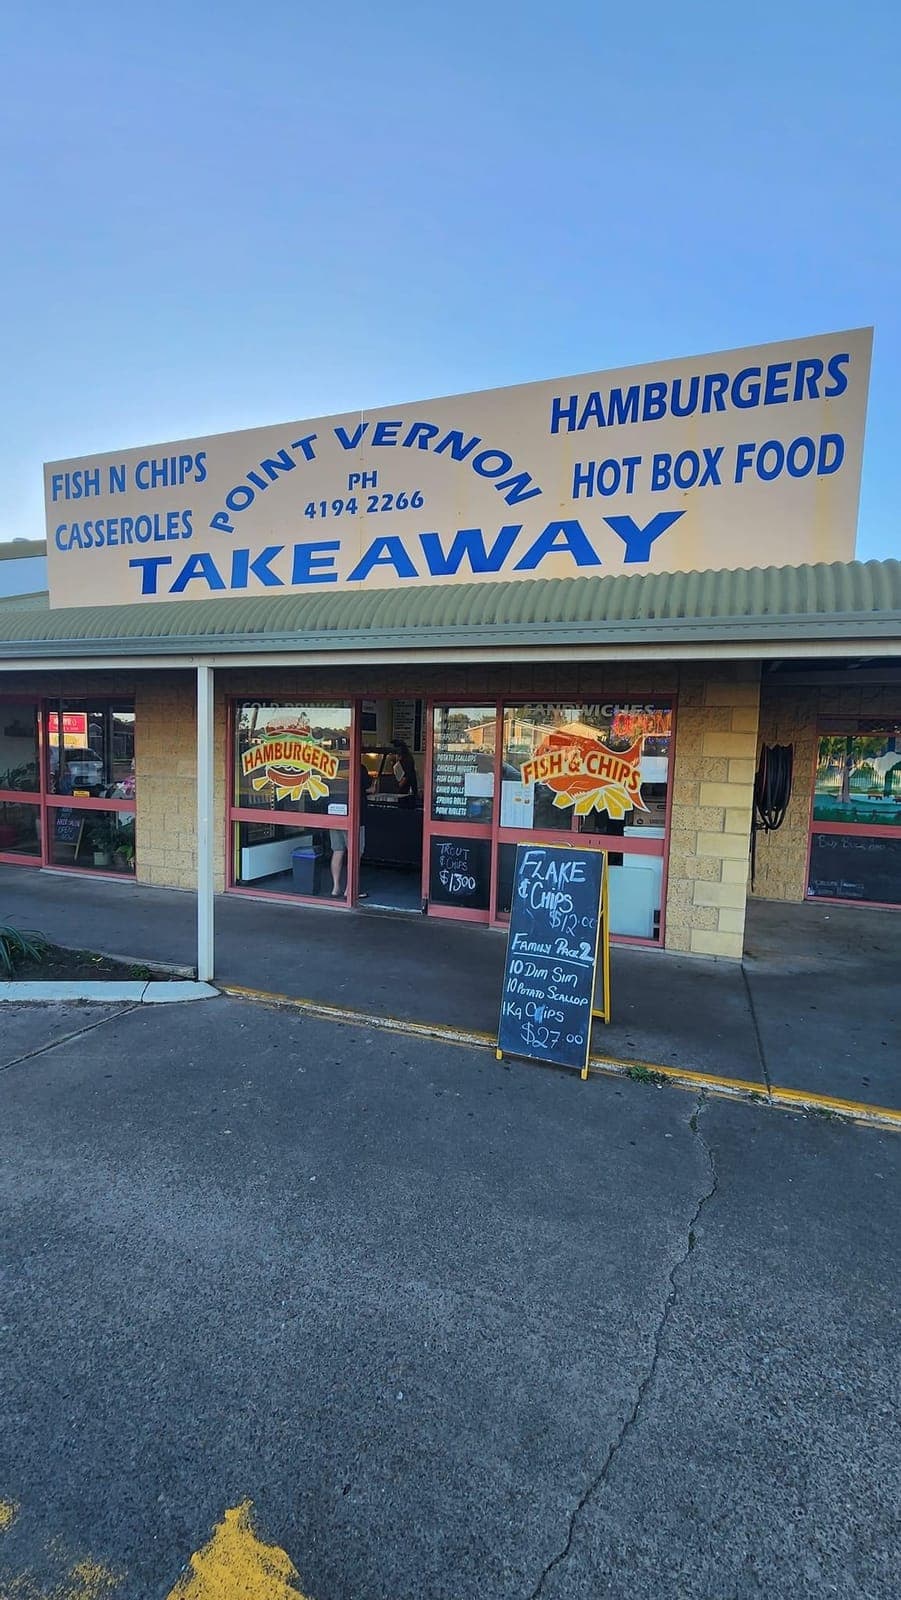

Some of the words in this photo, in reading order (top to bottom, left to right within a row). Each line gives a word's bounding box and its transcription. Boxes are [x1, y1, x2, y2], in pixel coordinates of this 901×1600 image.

[550, 353, 850, 434] HAMBURGERS
[51, 468, 100, 502] FISH
[109, 464, 126, 494] N
[134, 451, 207, 491] CHIPS
[209, 433, 318, 534] POINT
[333, 421, 543, 506] VERNON
[347, 470, 378, 491] PH
[572, 455, 642, 499] HOT
[651, 446, 726, 492] BOX
[734, 433, 845, 484] FOOD
[304, 498, 357, 519] 4194
[366, 490, 424, 512] 2266
[54, 509, 193, 551] CASSEROLES
[128, 509, 688, 596] TAKEAWAY
[524, 703, 654, 718] SANDWICHES
[243, 741, 339, 779] HAMBURGERS
[522, 753, 563, 785] FISH
[568, 751, 582, 773] &
[586, 752, 641, 791] CHIPS
[436, 842, 470, 860] TROUT
[520, 850, 587, 883] FLAKE
[509, 959, 524, 975] 10
[506, 977, 518, 993] 10
[546, 985, 589, 1007] SCALLOP
